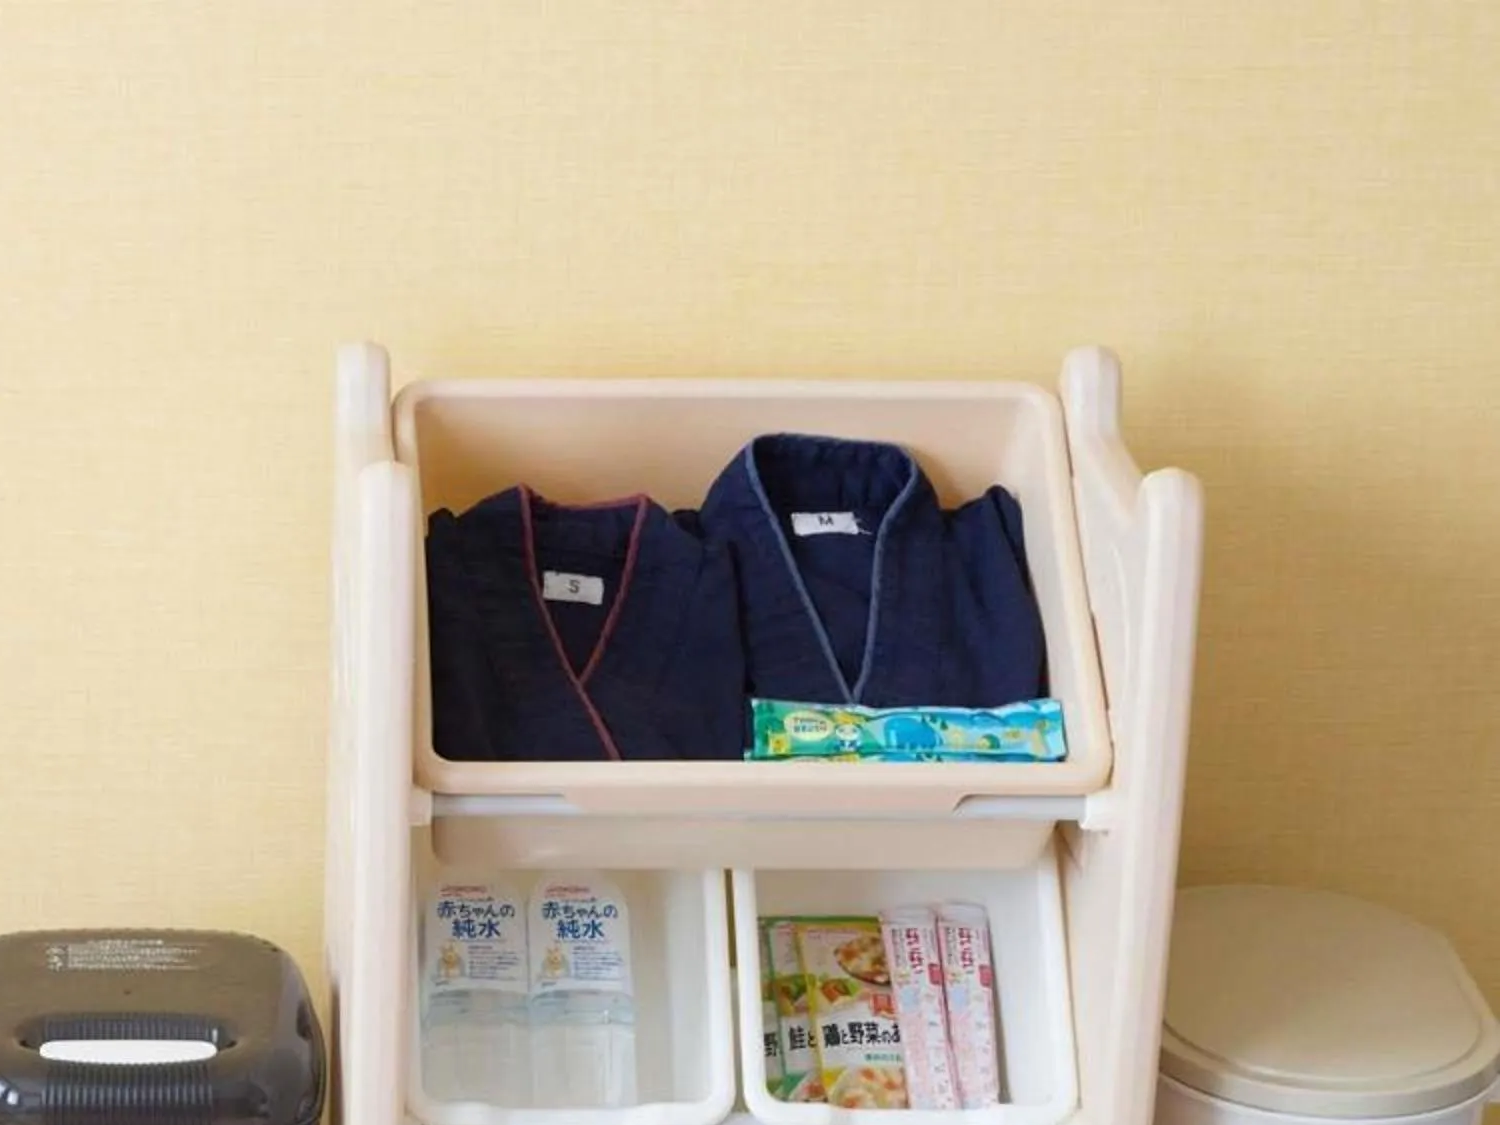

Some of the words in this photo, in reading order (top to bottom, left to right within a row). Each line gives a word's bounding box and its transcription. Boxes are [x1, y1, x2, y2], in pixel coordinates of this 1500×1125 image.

[568, 579, 580, 594] S
[437, 900, 516, 919] 赤ちゃんの
[542, 900, 619, 919] 赤ちゃんの
[452, 919, 501, 938] 純水
[556, 919, 605, 939] 純水
